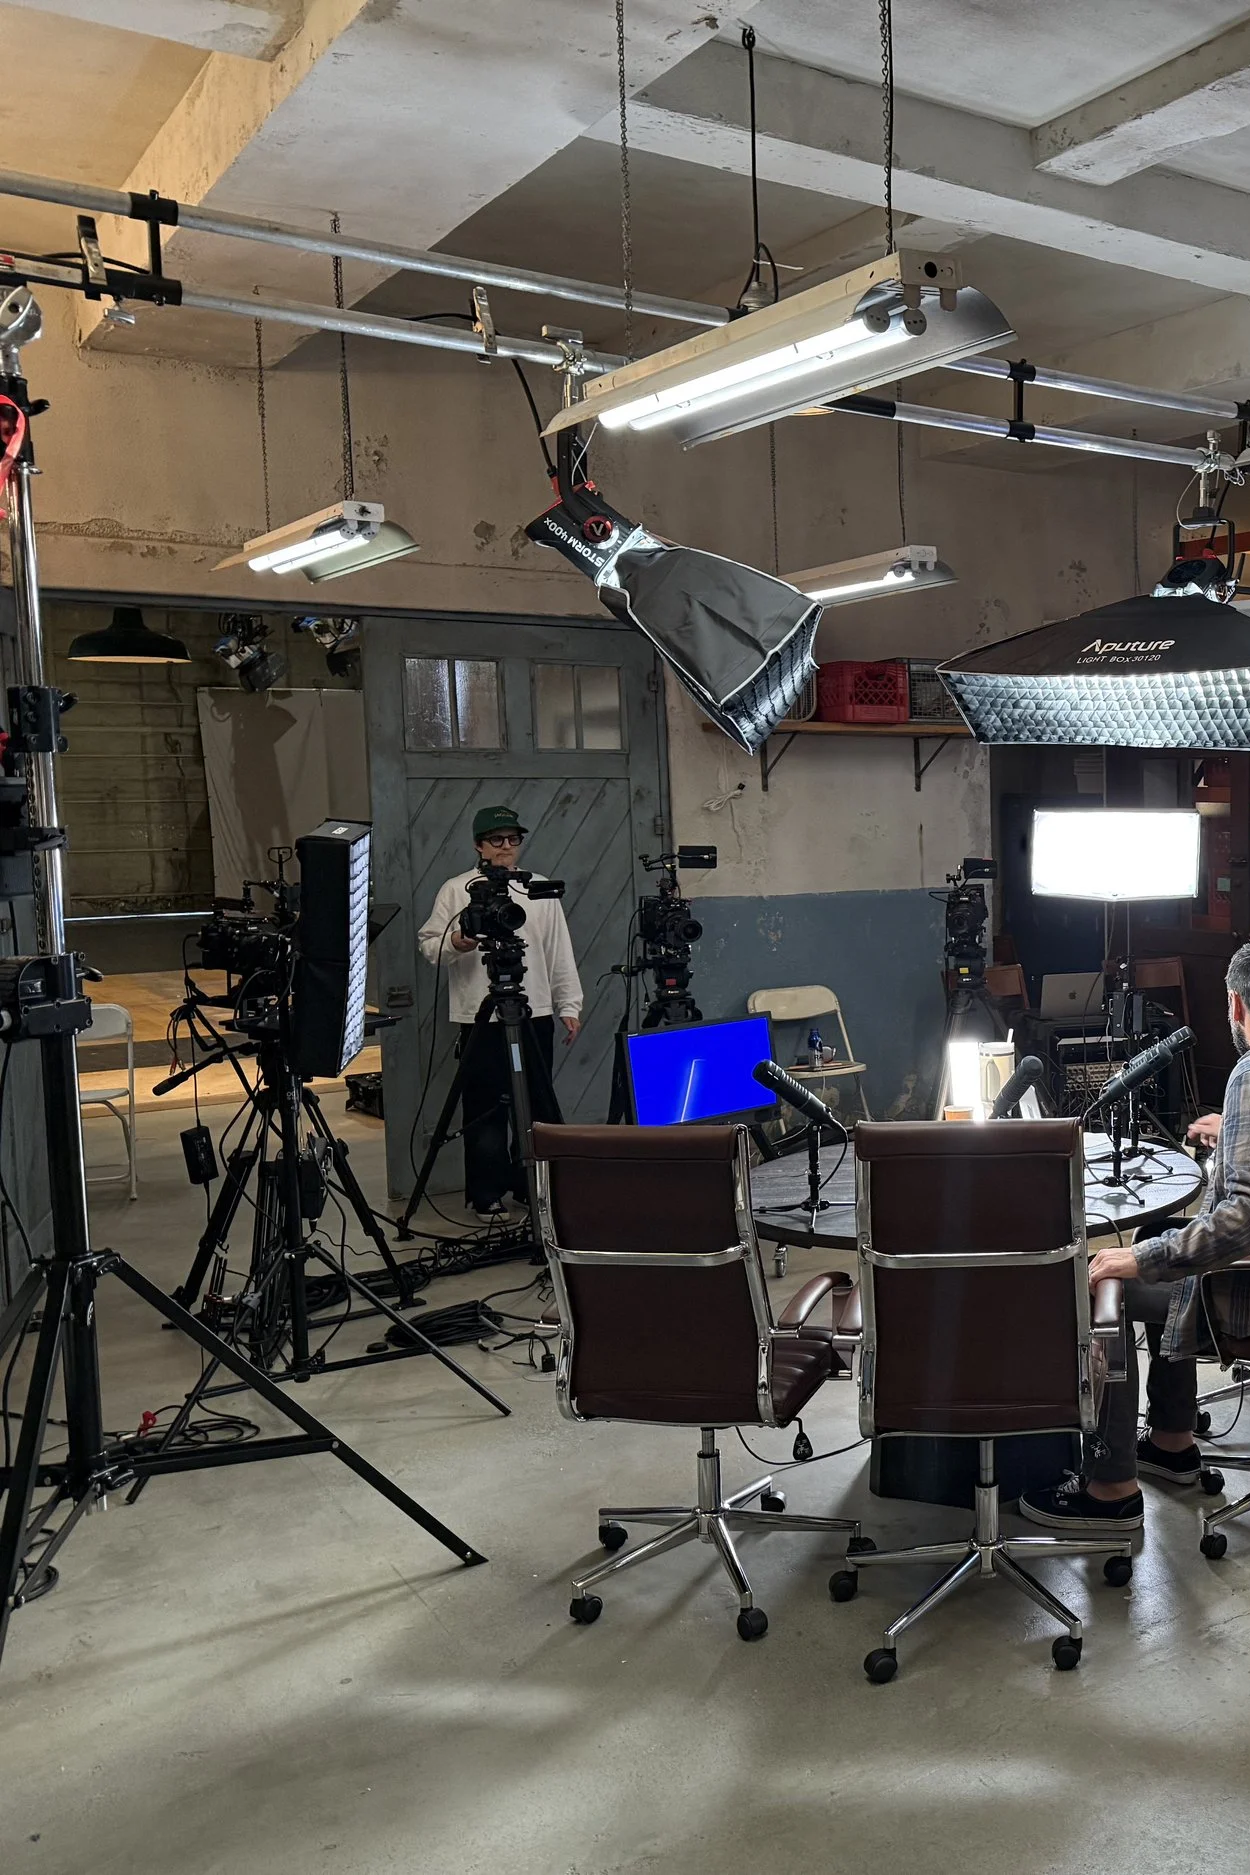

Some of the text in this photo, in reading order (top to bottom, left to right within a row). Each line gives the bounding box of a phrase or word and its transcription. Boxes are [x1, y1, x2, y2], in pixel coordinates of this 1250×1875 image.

[544, 517, 606, 568] STORM 400x
[1081, 639, 1175, 655] Aputure
[1077, 656, 1107, 664] LIGHT
